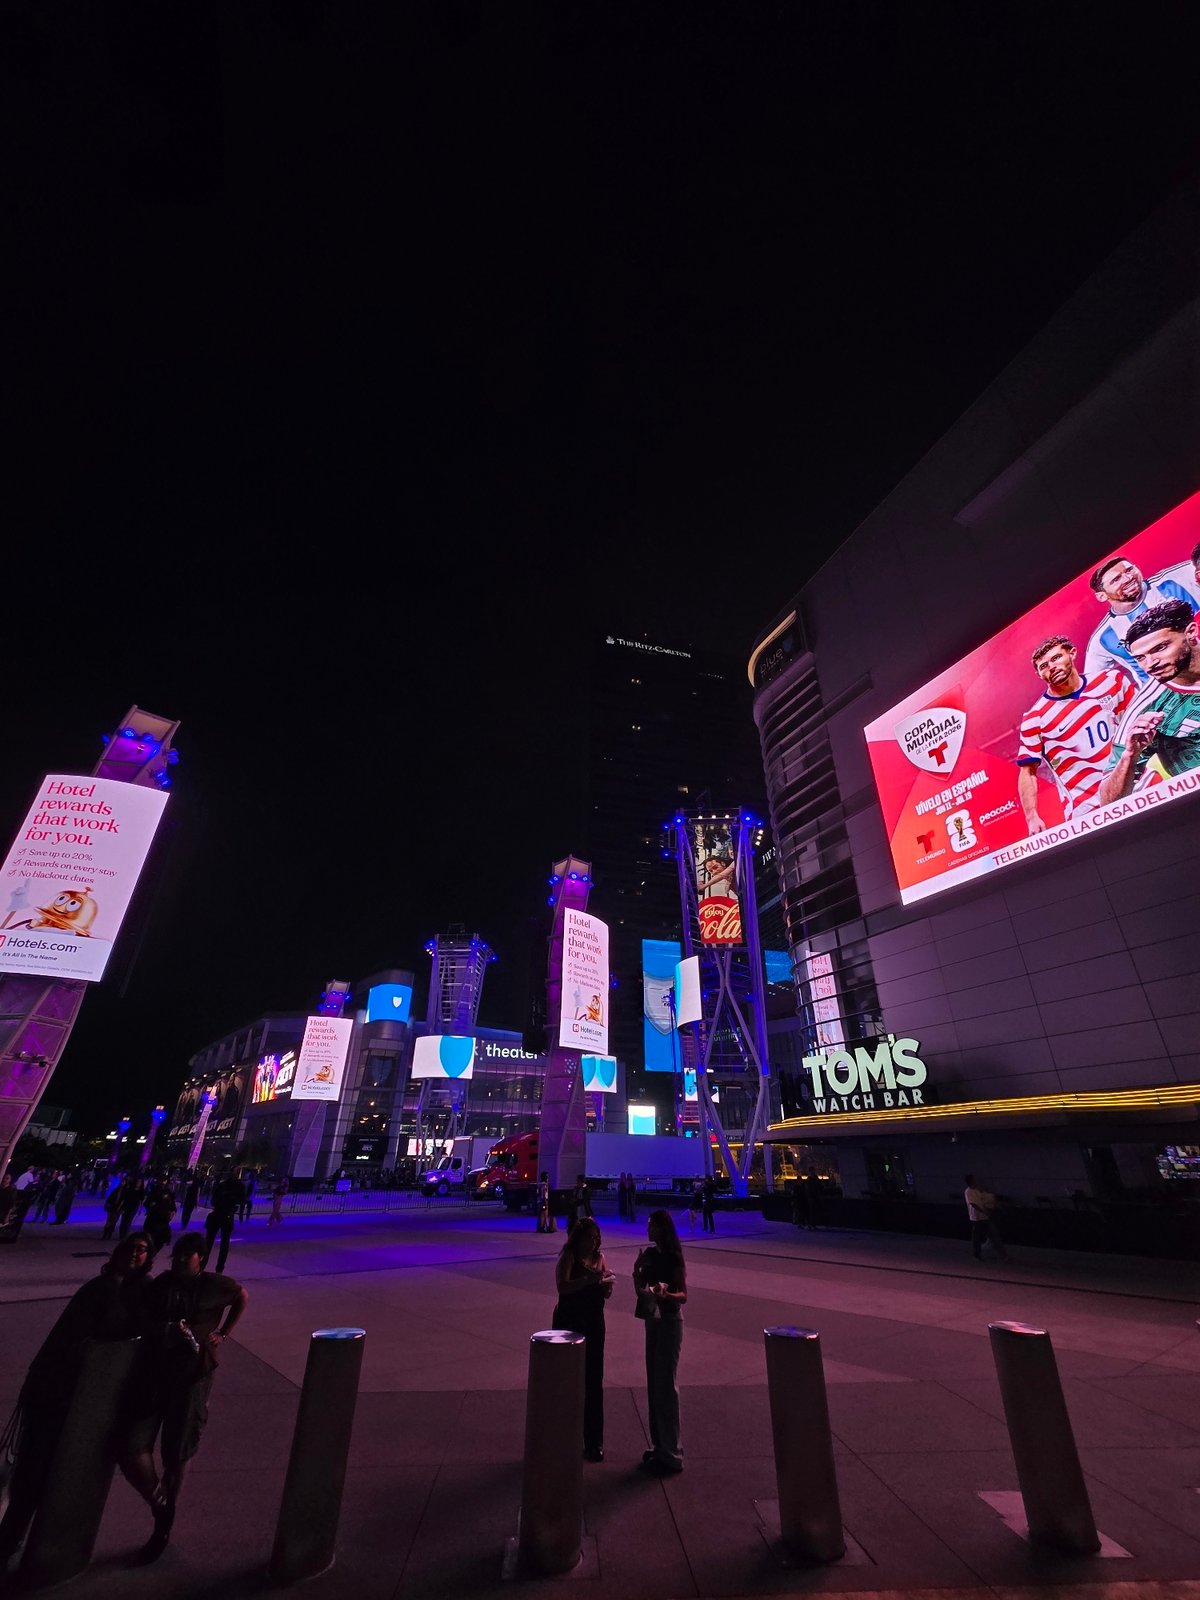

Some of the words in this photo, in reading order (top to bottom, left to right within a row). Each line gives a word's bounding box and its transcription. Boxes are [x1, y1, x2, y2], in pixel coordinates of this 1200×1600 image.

[904, 718, 935, 743] COPA
[906, 715, 960, 753] MUNDIAL
[928, 735, 943, 748] FIFA
[944, 723, 962, 738] 2026
[1085, 720, 1110, 749] 10
[47, 782, 96, 797] Hotel
[915, 793, 941, 816] VÍVELO
[940, 788, 953, 803] EN
[951, 769, 989, 798] ESPAÑOL
[965, 791, 973, 801] 19
[39, 800, 113, 815] rewards
[979, 799, 1016, 824] peacock
[33, 811, 69, 826] that
[73, 819, 120, 833] work
[992, 828, 1069, 867] TELEMUNDO
[1070, 820, 1091, 835] LA
[1092, 804, 1134, 827] CASA
[1135, 791, 1167, 810] DEL
[24, 827, 52, 841] for
[51, 832, 94, 846] you.
[959, 840, 970, 848] FIFA
[28, 848, 48, 857] Save
[49, 851, 60, 859] up
[71, 852, 93, 862] 20%
[915, 848, 946, 865] TELEMUNDO
[18, 870, 31, 878] No
[31, 870, 69, 881] blackout
[70, 874, 95, 884] dates
[23, 860, 59, 869] Rewards
[73, 865, 98, 876] every
[98, 868, 118, 878] stay
[569, 914, 591, 929] Hotel
[568, 927, 599, 943] rewards
[568, 936, 585, 949] that
[586, 943, 603, 956] work
[568, 946, 581, 958] for
[581, 952, 598, 965] you.
[802, 1033, 927, 1098] TOM'S
[812, 1093, 875, 1113] WATCH
[883, 1088, 925, 1107] BAR
